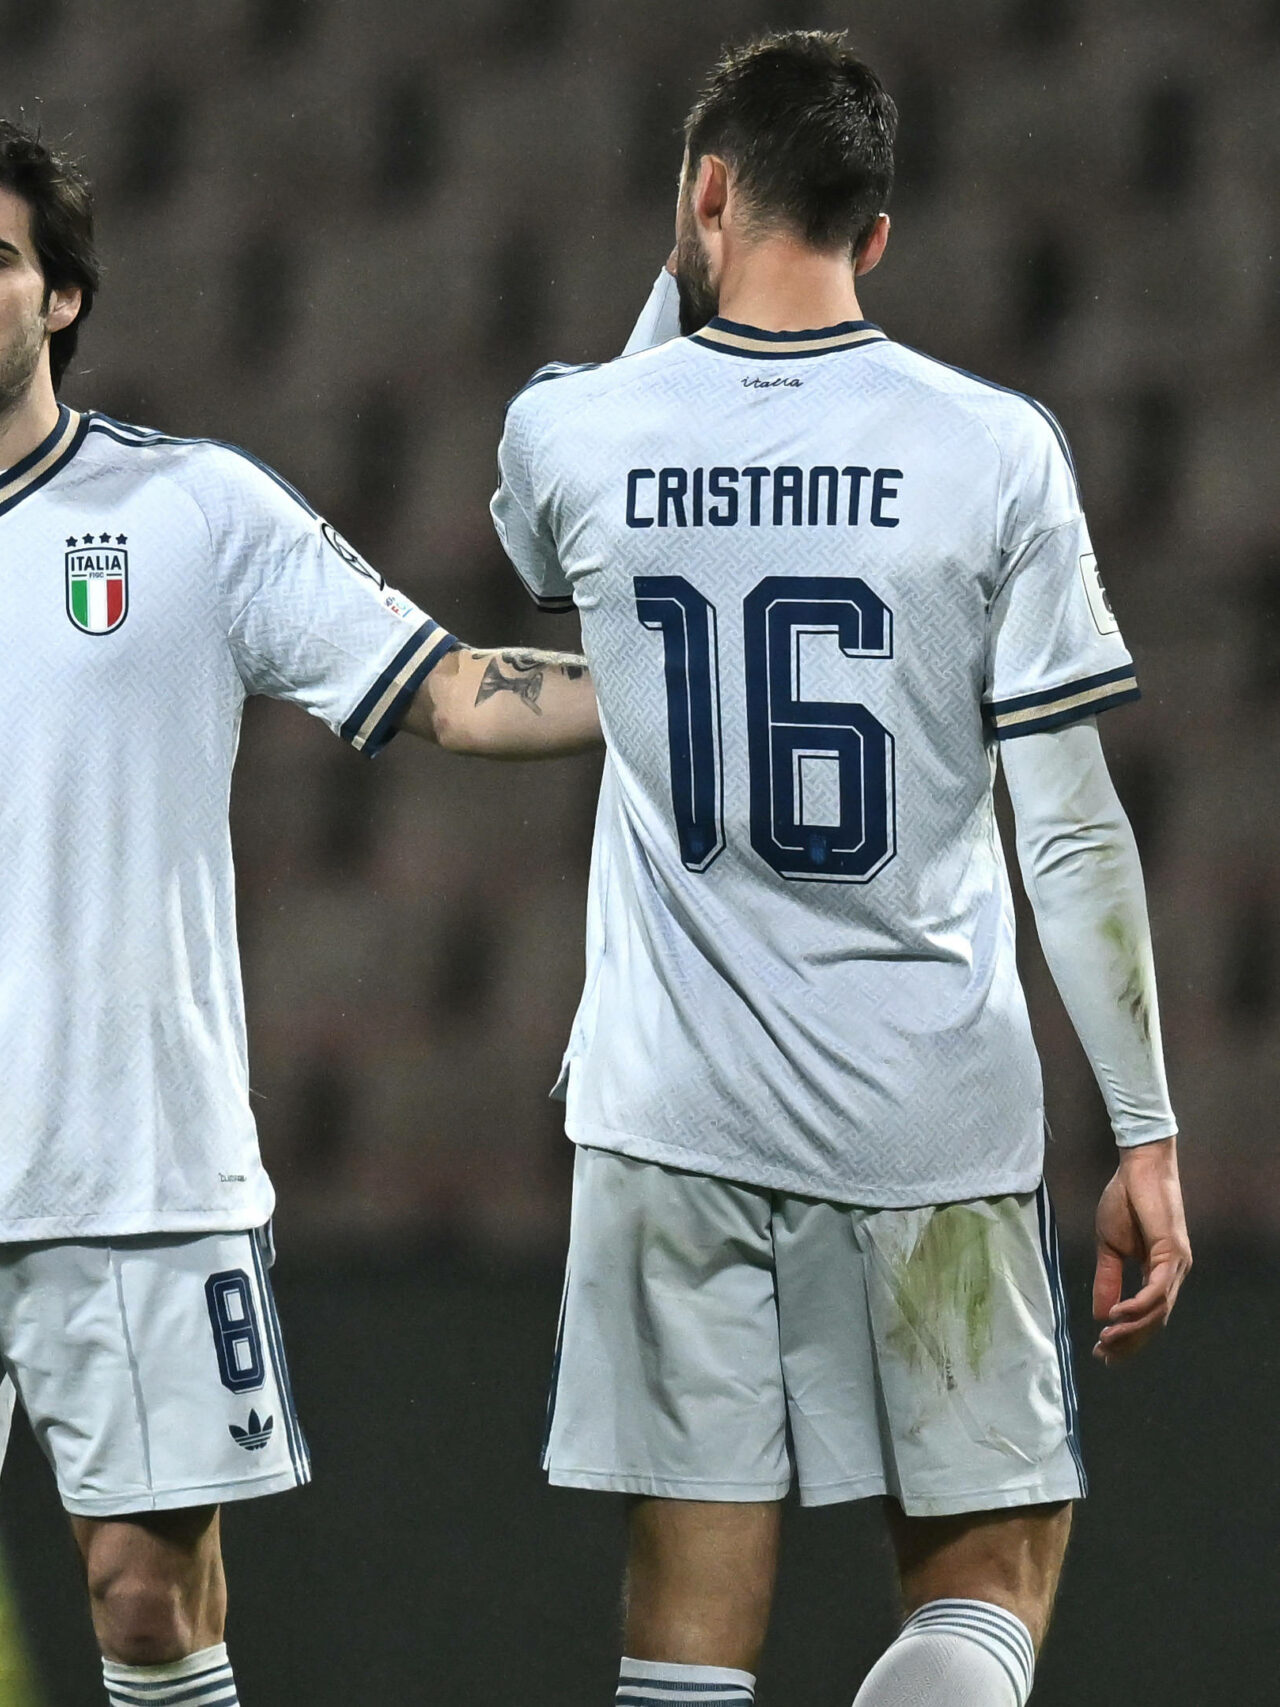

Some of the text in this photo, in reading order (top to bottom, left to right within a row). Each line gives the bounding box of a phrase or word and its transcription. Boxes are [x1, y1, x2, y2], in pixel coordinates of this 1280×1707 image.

[625, 465, 904, 529] CRISTANTE
[70, 554, 122, 572] ITALIA
[631, 575, 898, 884] 16
[204, 1268, 267, 1395] 8
